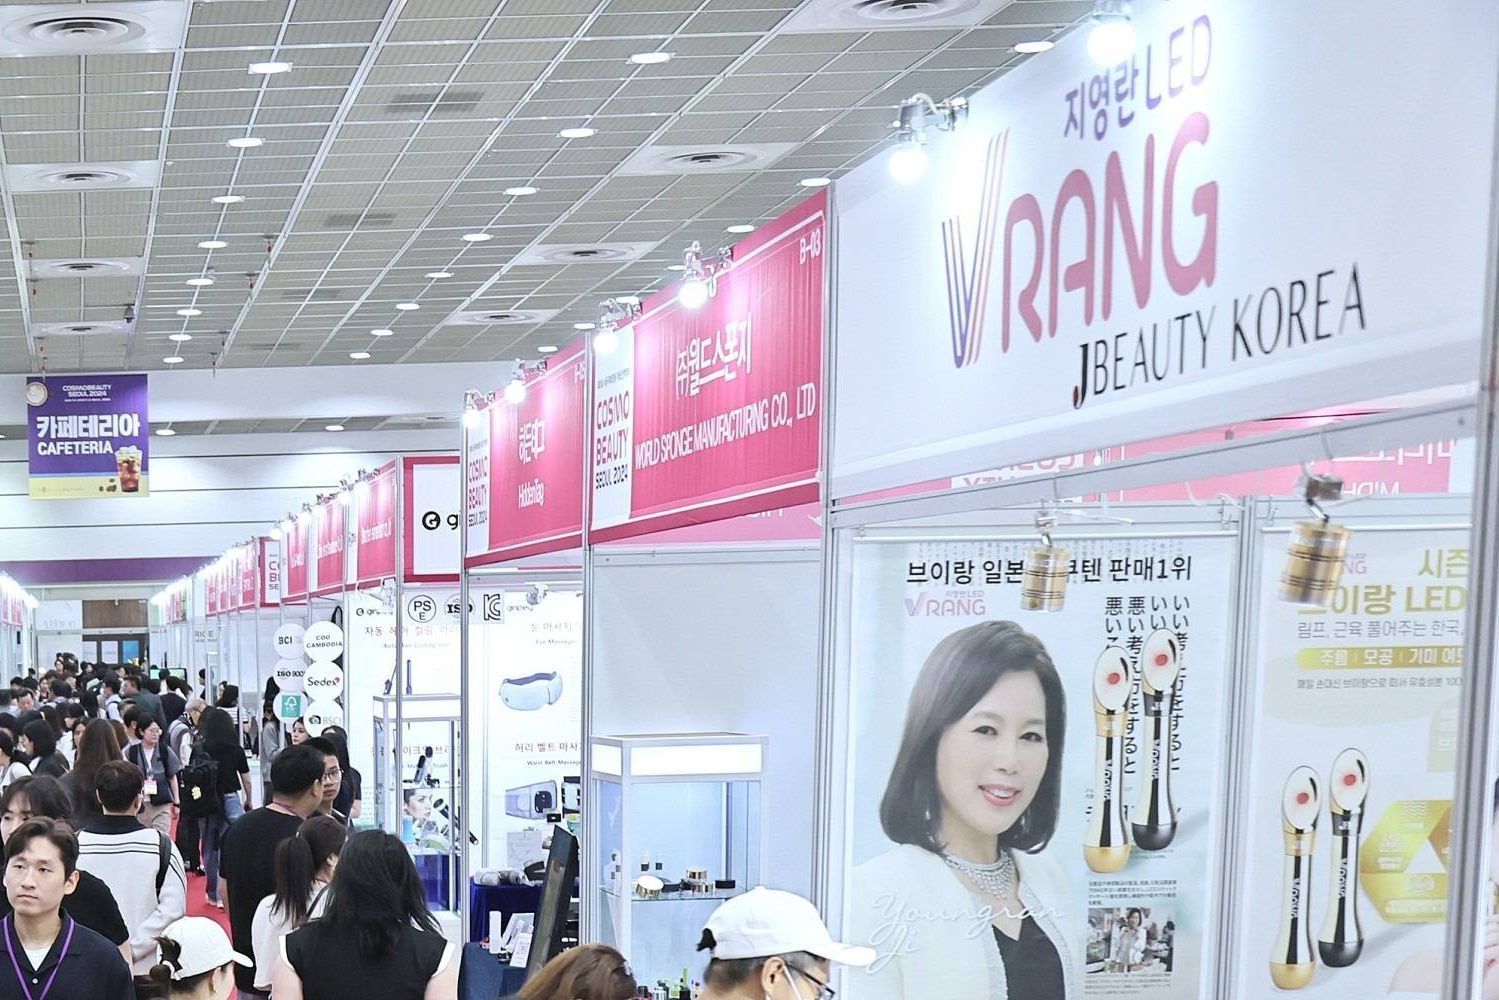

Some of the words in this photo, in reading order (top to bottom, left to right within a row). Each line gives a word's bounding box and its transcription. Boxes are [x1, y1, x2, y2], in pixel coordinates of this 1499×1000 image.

[1063, 53, 1140, 141] 지영란
[1145, 13, 1214, 109] LED
[800, 228, 821, 266] B-03
[942, 111, 1219, 369] VRANG
[1232, 261, 1367, 363] KOREA
[36, 413, 141, 439] 카페테리아
[694, 398, 769, 453] MANUFACTURING
[797, 382, 816, 420] LTD
[37, 440, 114, 456] CAFETERIA
[596, 428, 629, 467] BEAUTY
[907, 560, 974, 586] 브이랑
[983, 559, 1023, 585] 일본
[1109, 555, 1192, 582] 판매1위
[905, 591, 987, 617] VRANG
[1405, 585, 1469, 612] LED
[1367, 620, 1427, 638] 풀어주는
[1363, 649, 1393, 665] 모공
[1410, 648, 1438, 665] 기미
[307, 677, 337, 687] Sedex
